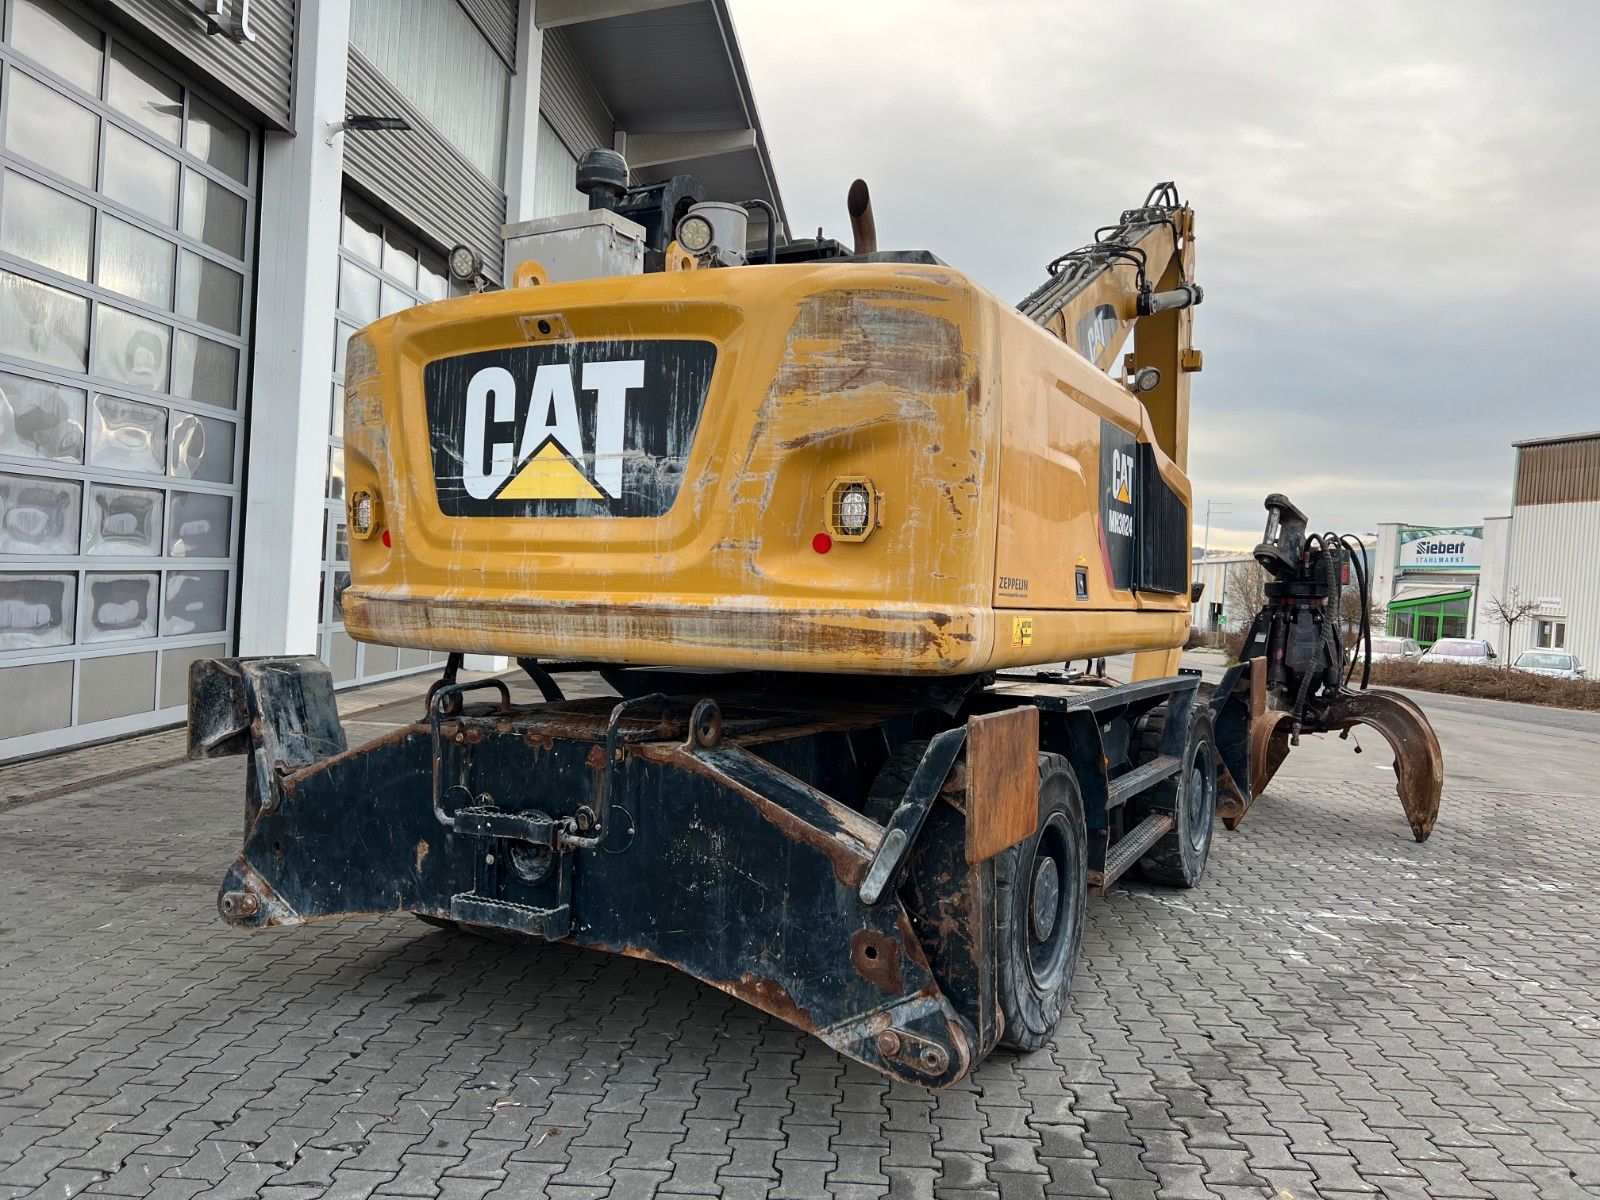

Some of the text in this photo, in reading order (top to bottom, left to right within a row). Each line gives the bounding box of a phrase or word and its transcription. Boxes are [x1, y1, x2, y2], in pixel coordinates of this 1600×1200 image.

[463, 359, 645, 500] CAT
[1112, 449, 1134, 504] CAT
[1108, 509, 1133, 537] MH3024
[1416, 541, 1465, 554] Siebert
[999, 576, 1028, 591] ZEPPELIN
